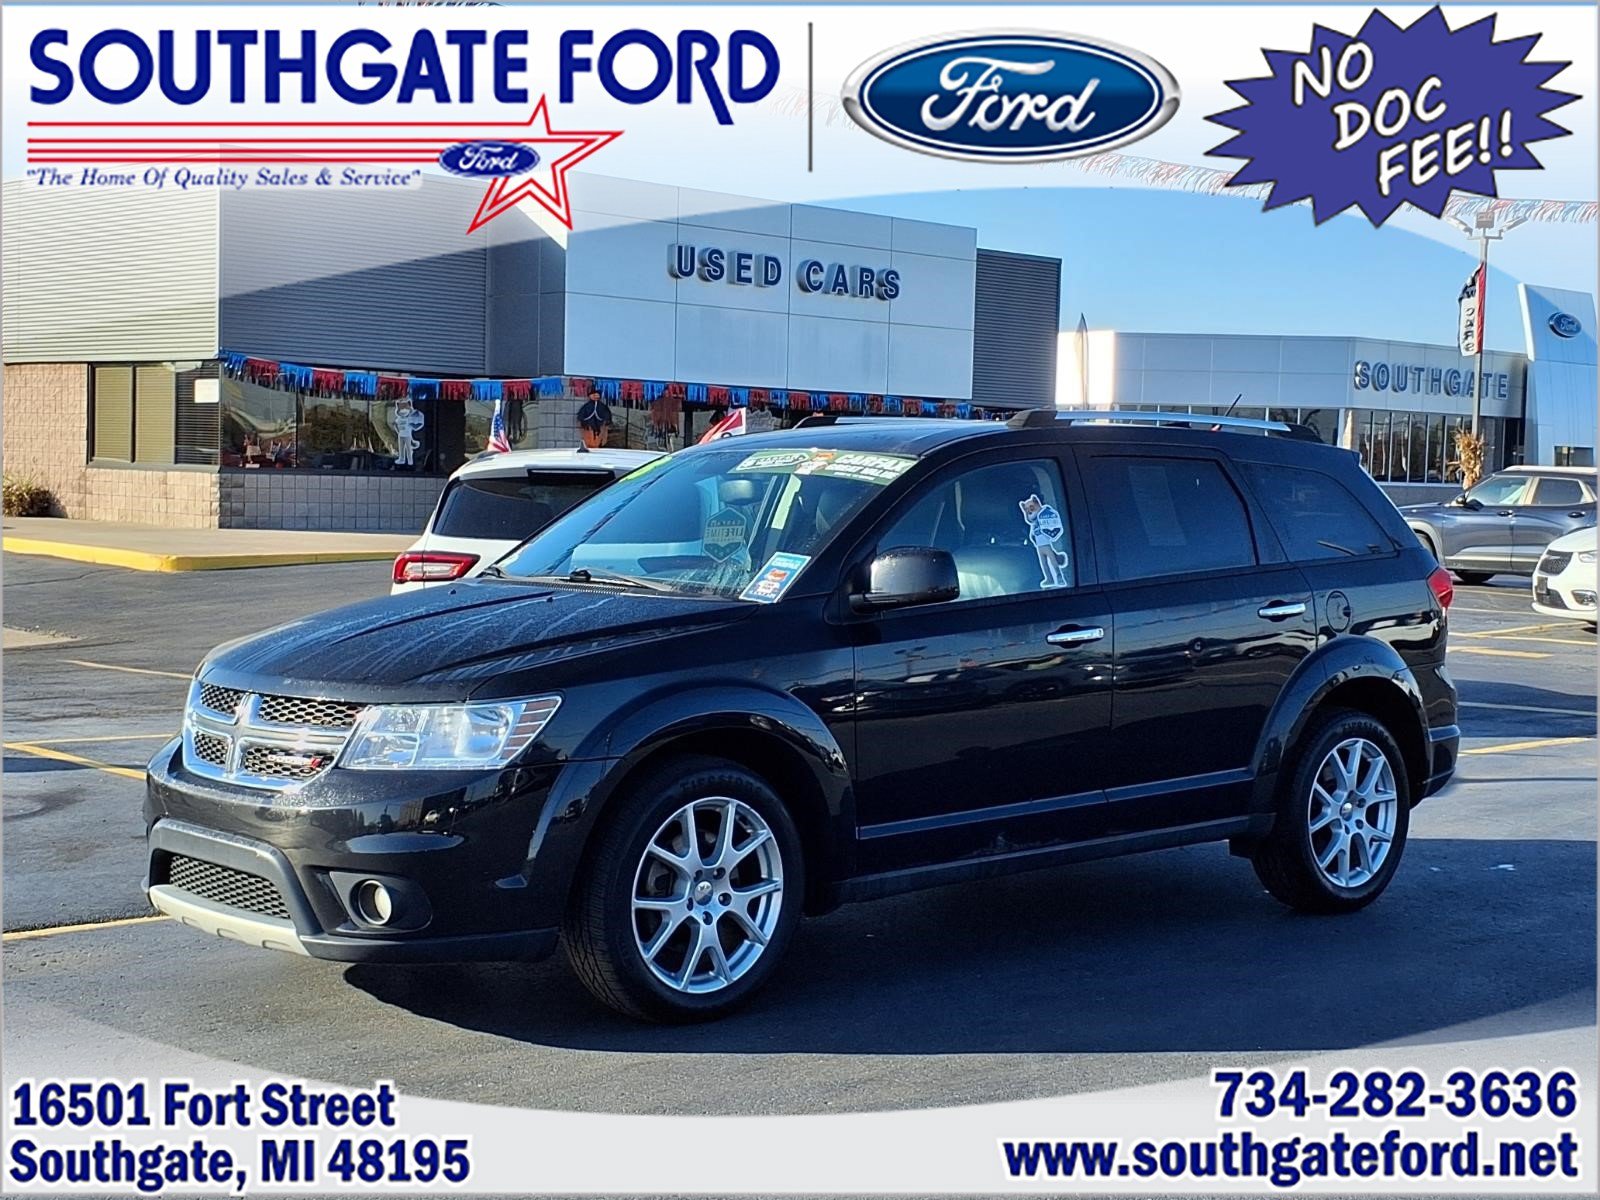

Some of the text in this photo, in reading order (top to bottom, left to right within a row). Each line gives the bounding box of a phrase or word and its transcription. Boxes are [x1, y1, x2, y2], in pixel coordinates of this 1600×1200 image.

[667, 243, 901, 301] USED CARS
[1354, 360, 1509, 399] SOUTHGATE
